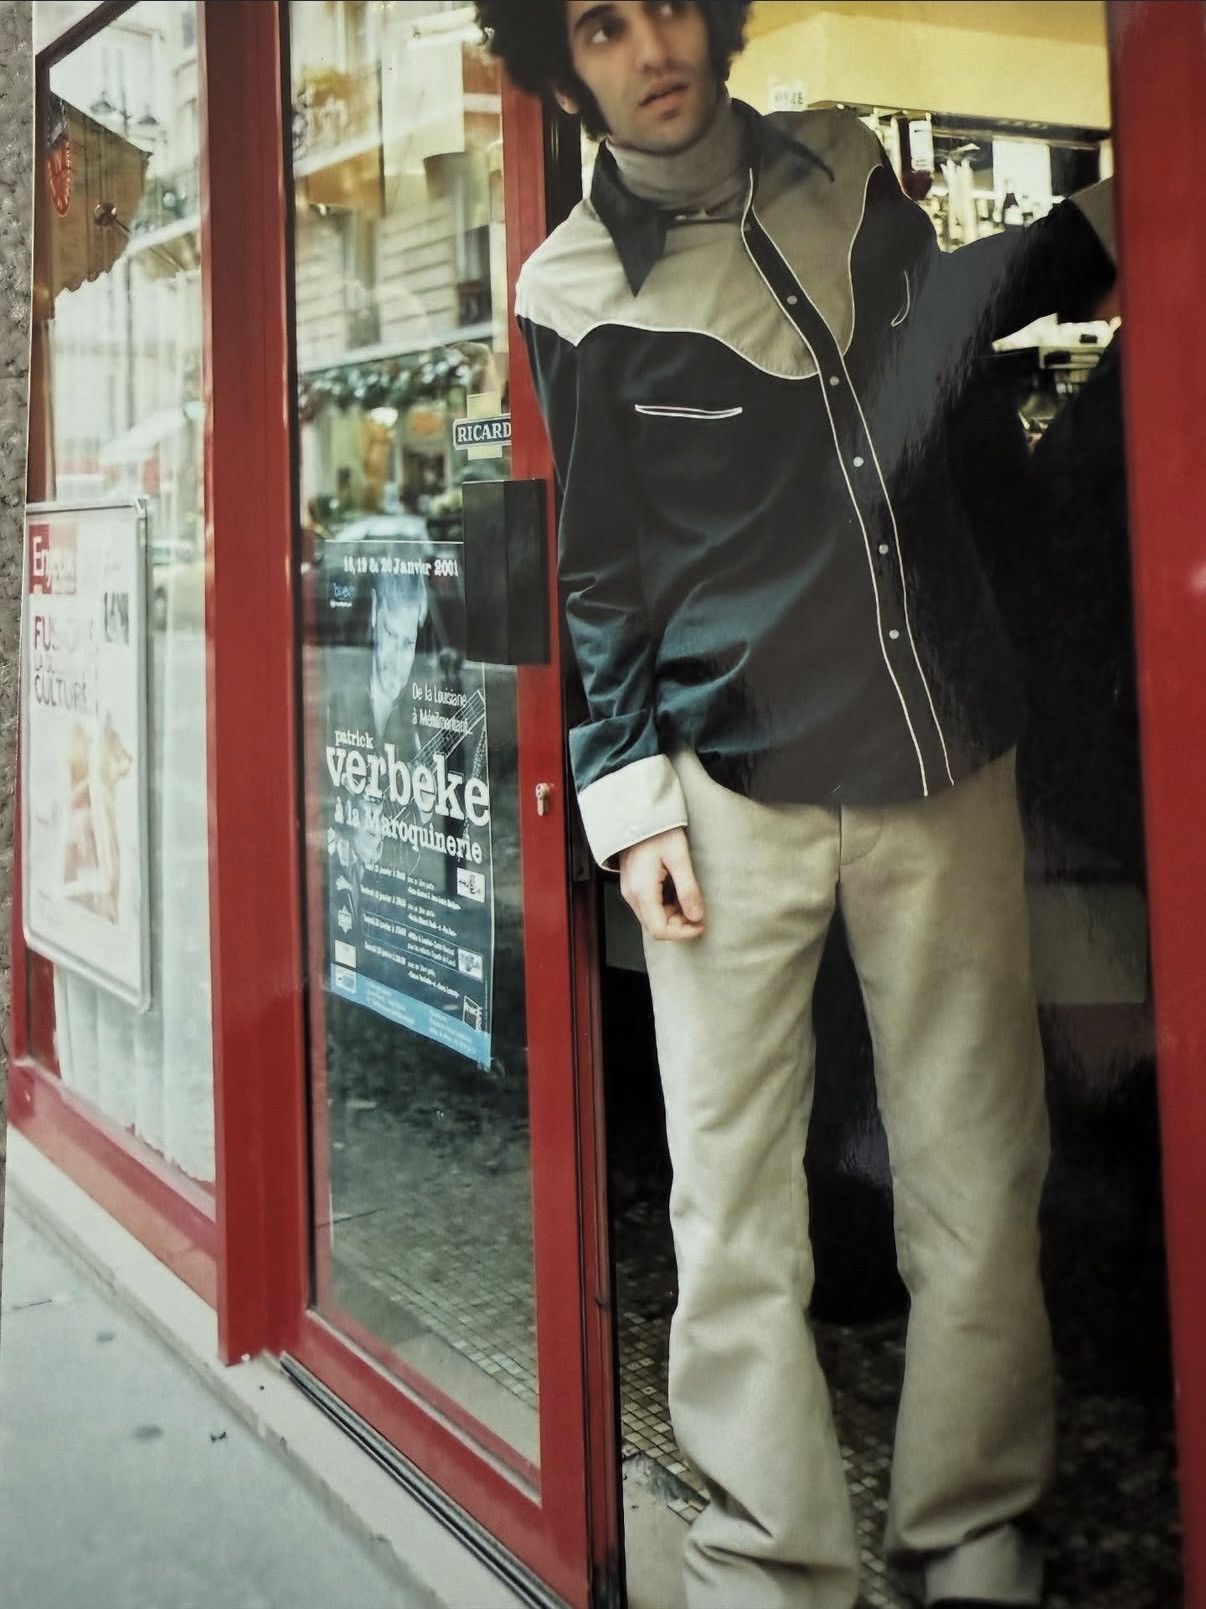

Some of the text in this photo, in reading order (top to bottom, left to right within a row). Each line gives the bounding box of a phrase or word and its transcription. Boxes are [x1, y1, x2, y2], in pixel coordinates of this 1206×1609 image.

[458, 422, 511, 442] RICARD
[412, 682, 422, 700] De
[424, 684, 432, 701] la
[335, 729, 374, 749] patrick
[326, 743, 491, 827] verbeke
[346, 799, 360, 828] la
[365, 806, 483, 865] Maroquinerie
